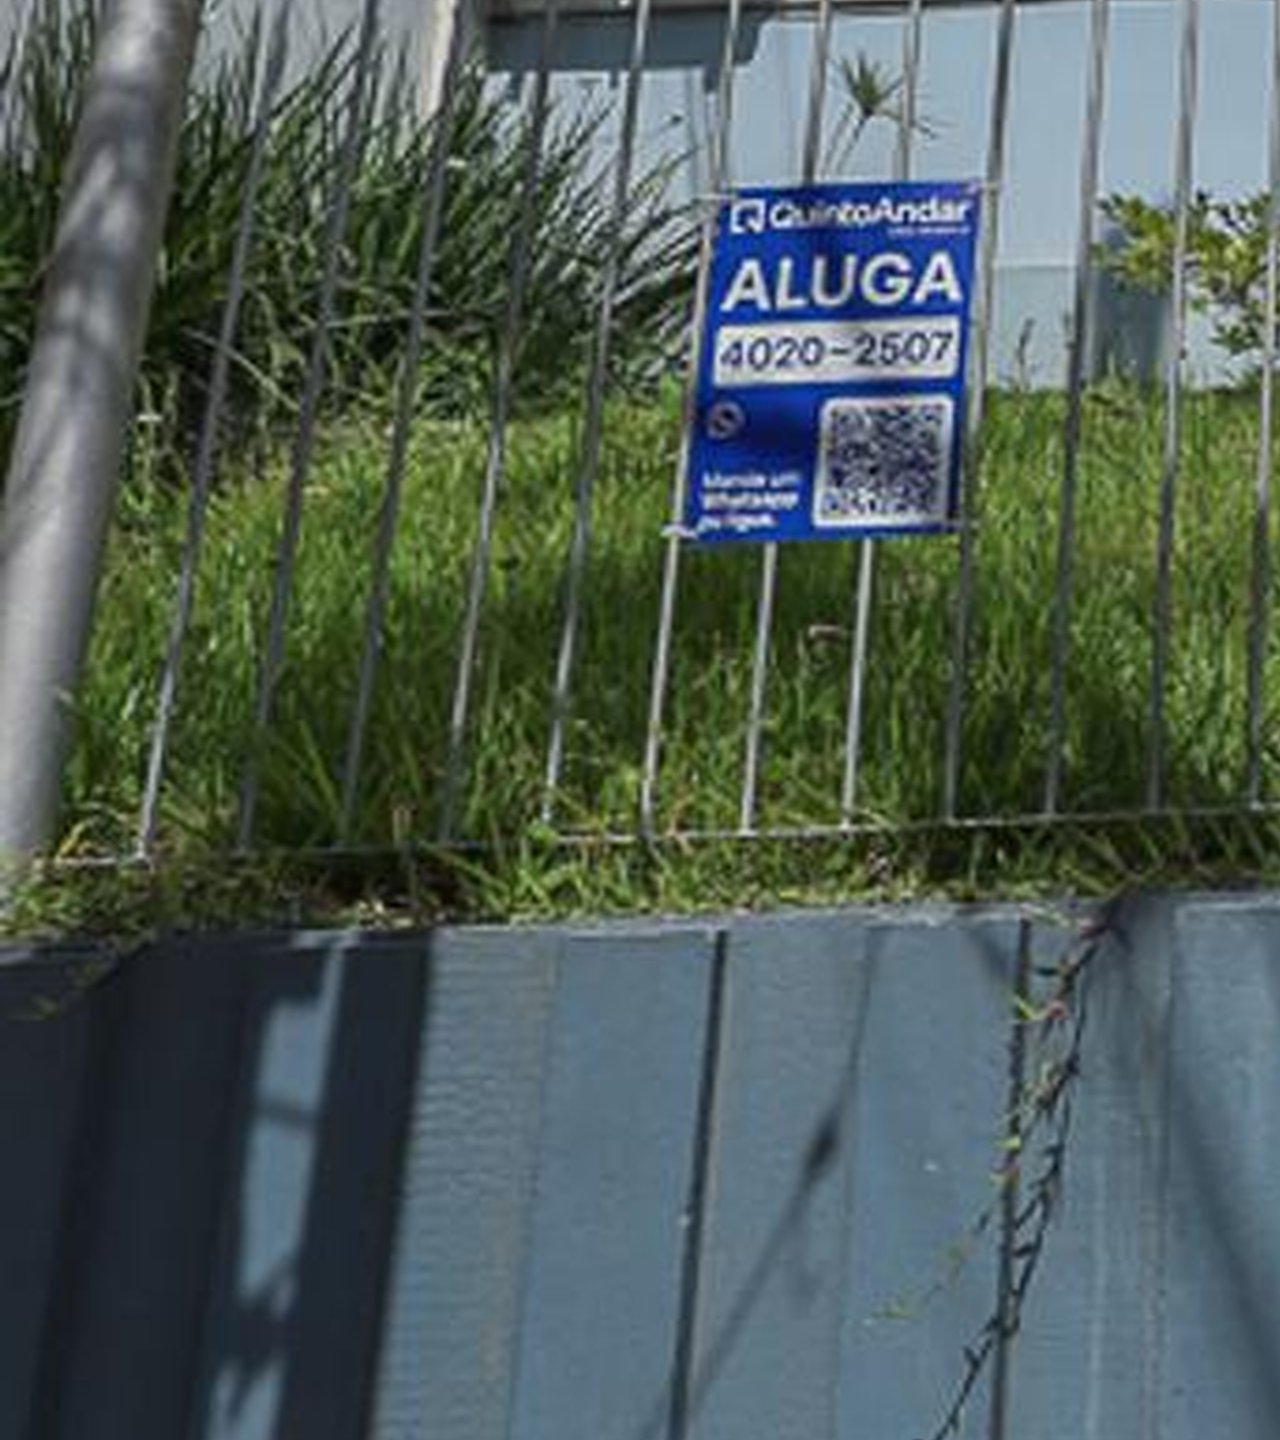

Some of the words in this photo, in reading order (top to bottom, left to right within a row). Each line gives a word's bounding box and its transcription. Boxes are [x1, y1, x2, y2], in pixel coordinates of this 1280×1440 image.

[770, 197, 971, 227] QuintoAndar
[720, 251, 963, 312] ALUGA
[720, 331, 953, 372] 4020-2507
